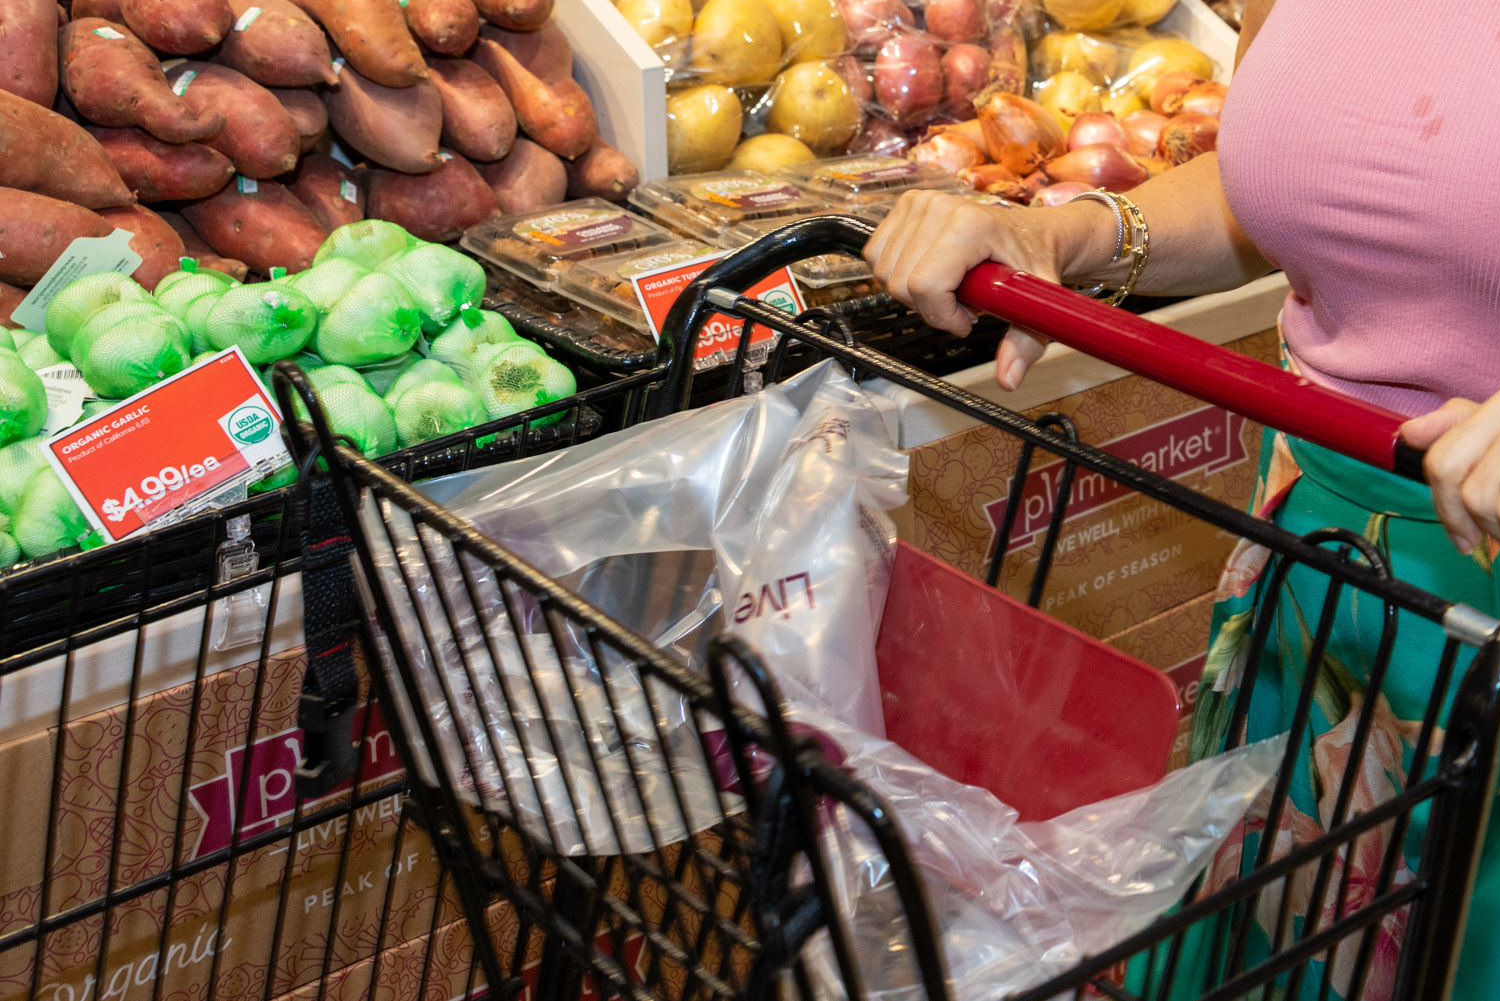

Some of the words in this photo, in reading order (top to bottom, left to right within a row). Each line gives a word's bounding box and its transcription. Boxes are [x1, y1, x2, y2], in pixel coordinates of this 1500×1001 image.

[645, 276, 681, 291] ORGANIC
[62, 425, 111, 455] ORGANIC
[112, 404, 151, 430] GARLIC
[68, 445, 96, 464] Product
[104, 424, 136, 446] California
[136, 417, 151, 430] (US)
[235, 413, 260, 429] USDA
[240, 420, 268, 439] ORGANIC
[101, 456, 221, 522] $4.99/ea
[1024, 471, 1104, 532] plm
[1113, 426, 1214, 488] arket
[734, 571, 816, 624] Live
[1046, 580, 1088, 611] PEAK
[1093, 571, 1116, 591] OF
[1120, 543, 1183, 580] SEASON
[304, 871, 374, 914] PEAK
[384, 852, 419, 879] OF
